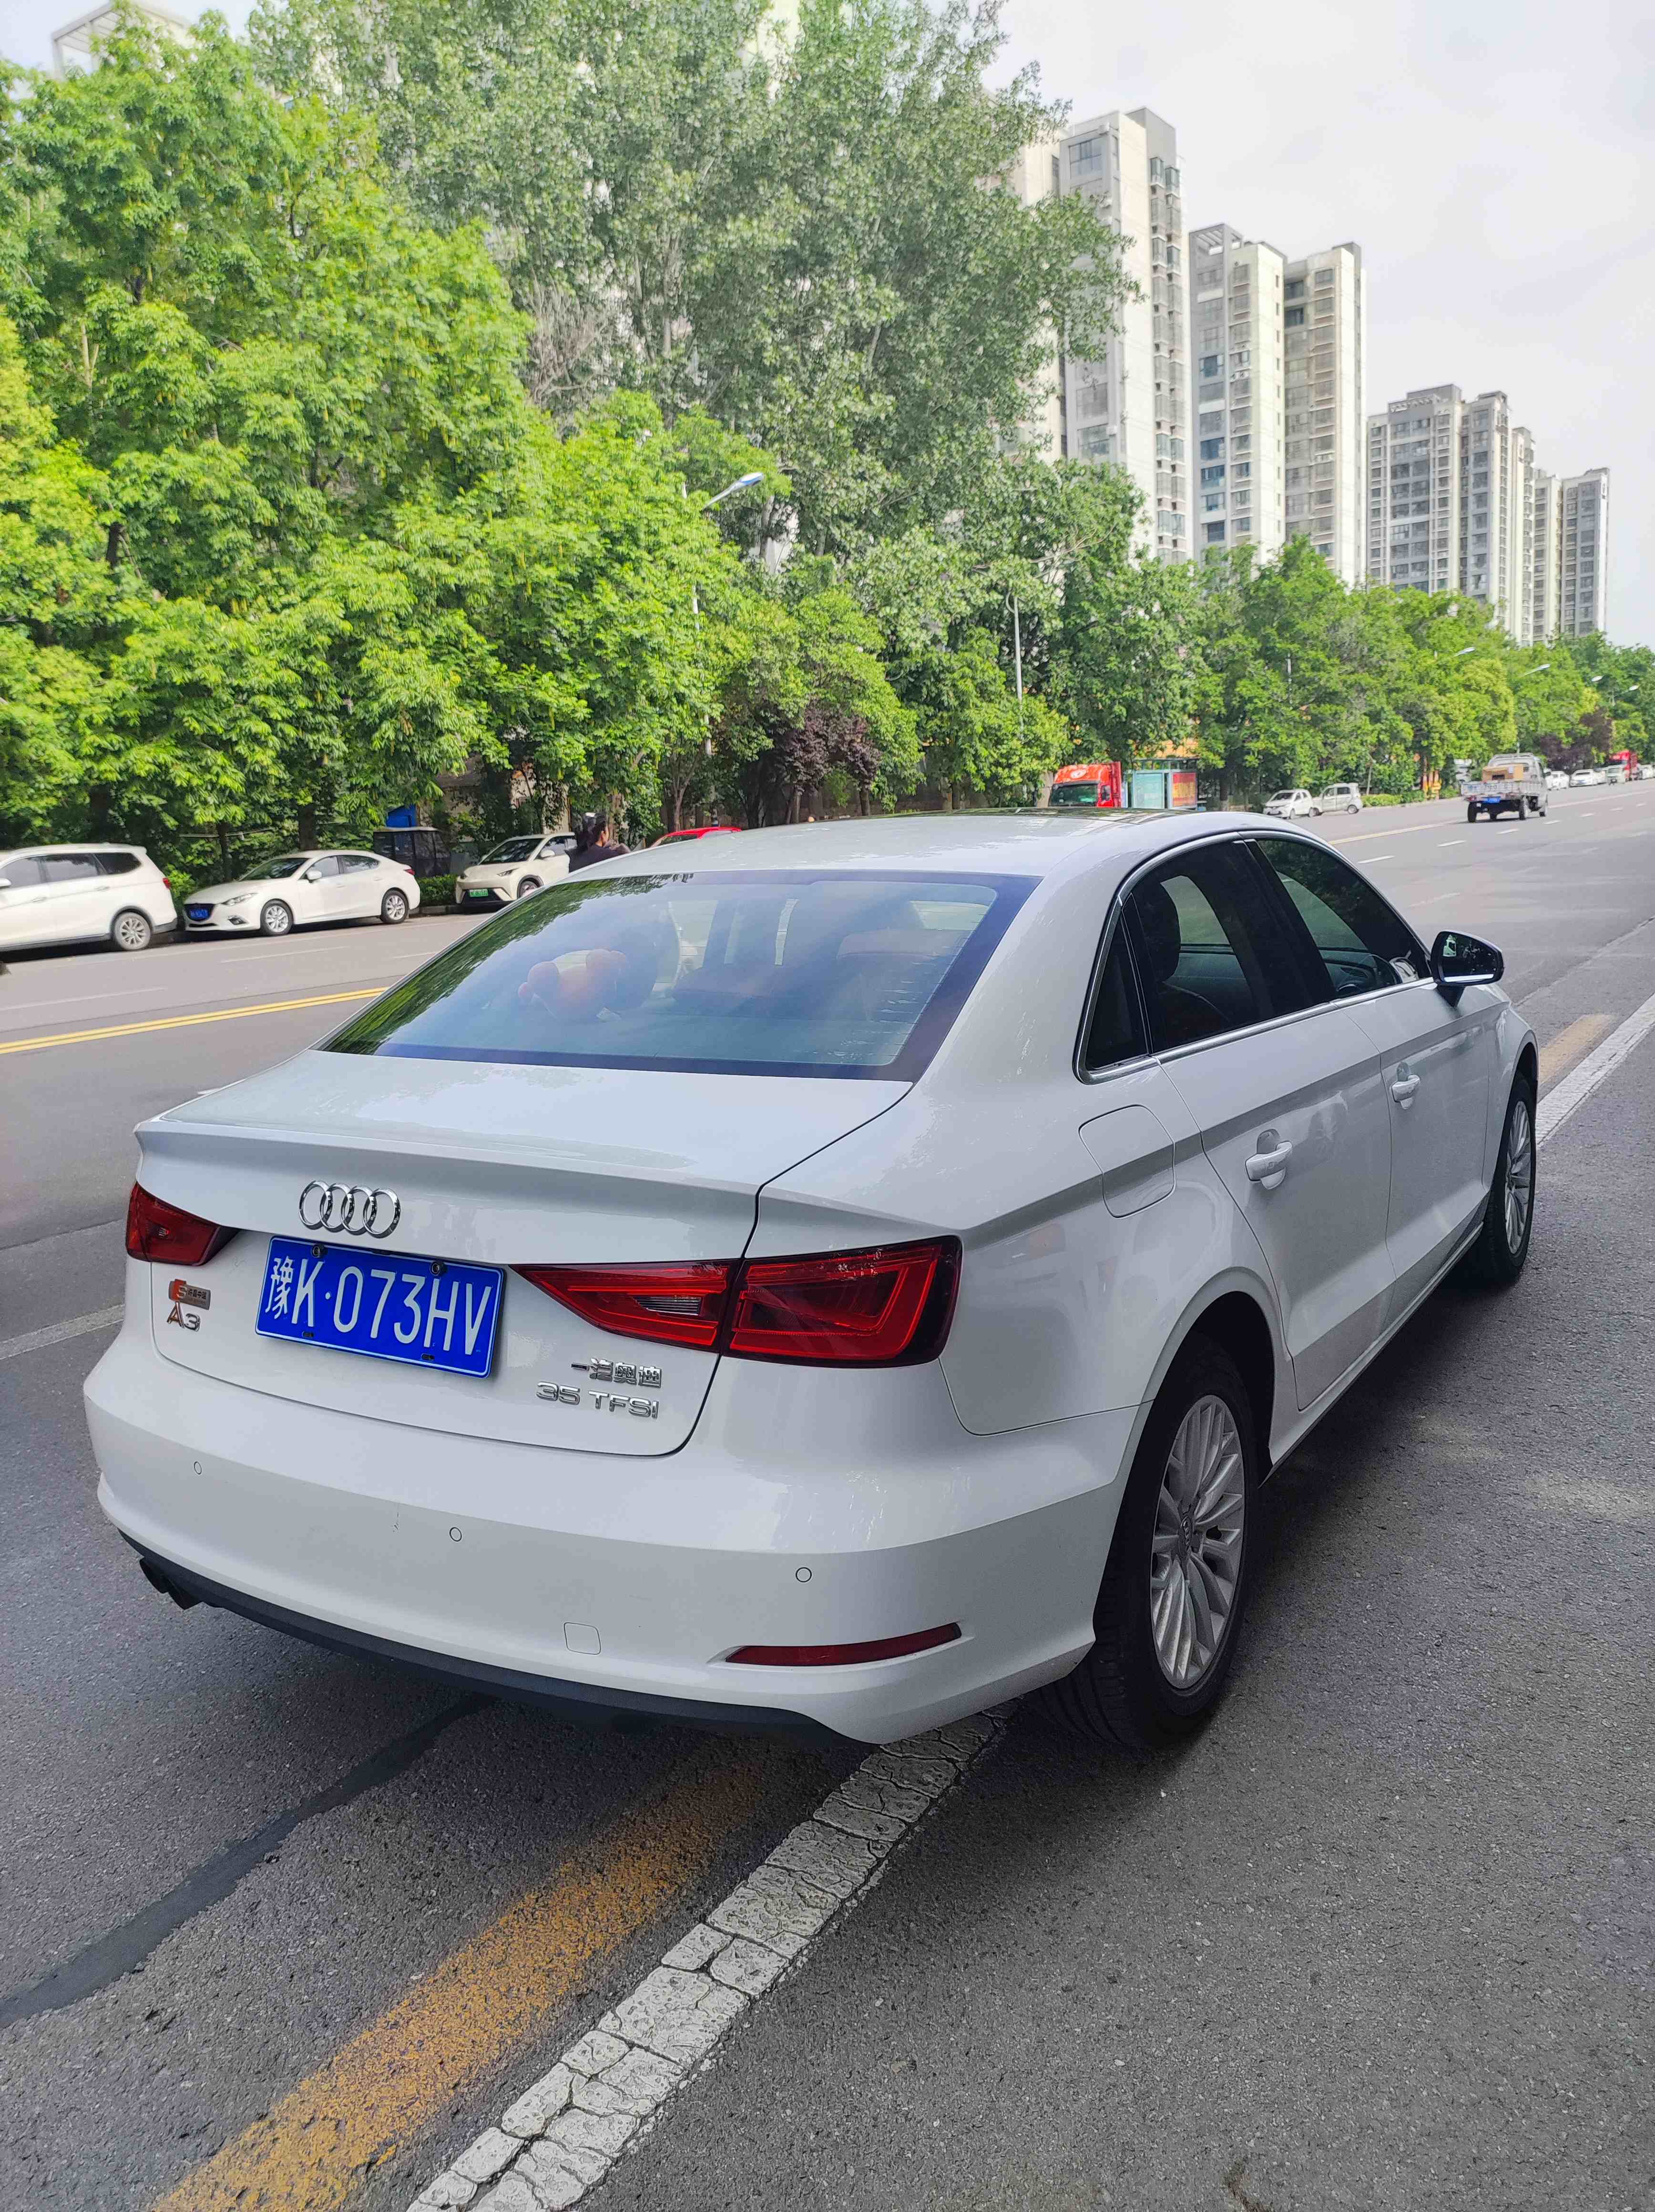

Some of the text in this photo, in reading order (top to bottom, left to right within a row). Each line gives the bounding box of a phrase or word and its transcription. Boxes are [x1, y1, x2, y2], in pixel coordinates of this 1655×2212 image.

[167, 1301, 201, 1331] A3
[571, 1357, 662, 1388] 一汽奥迪
[536, 1382, 660, 1419] 35 TFSI
